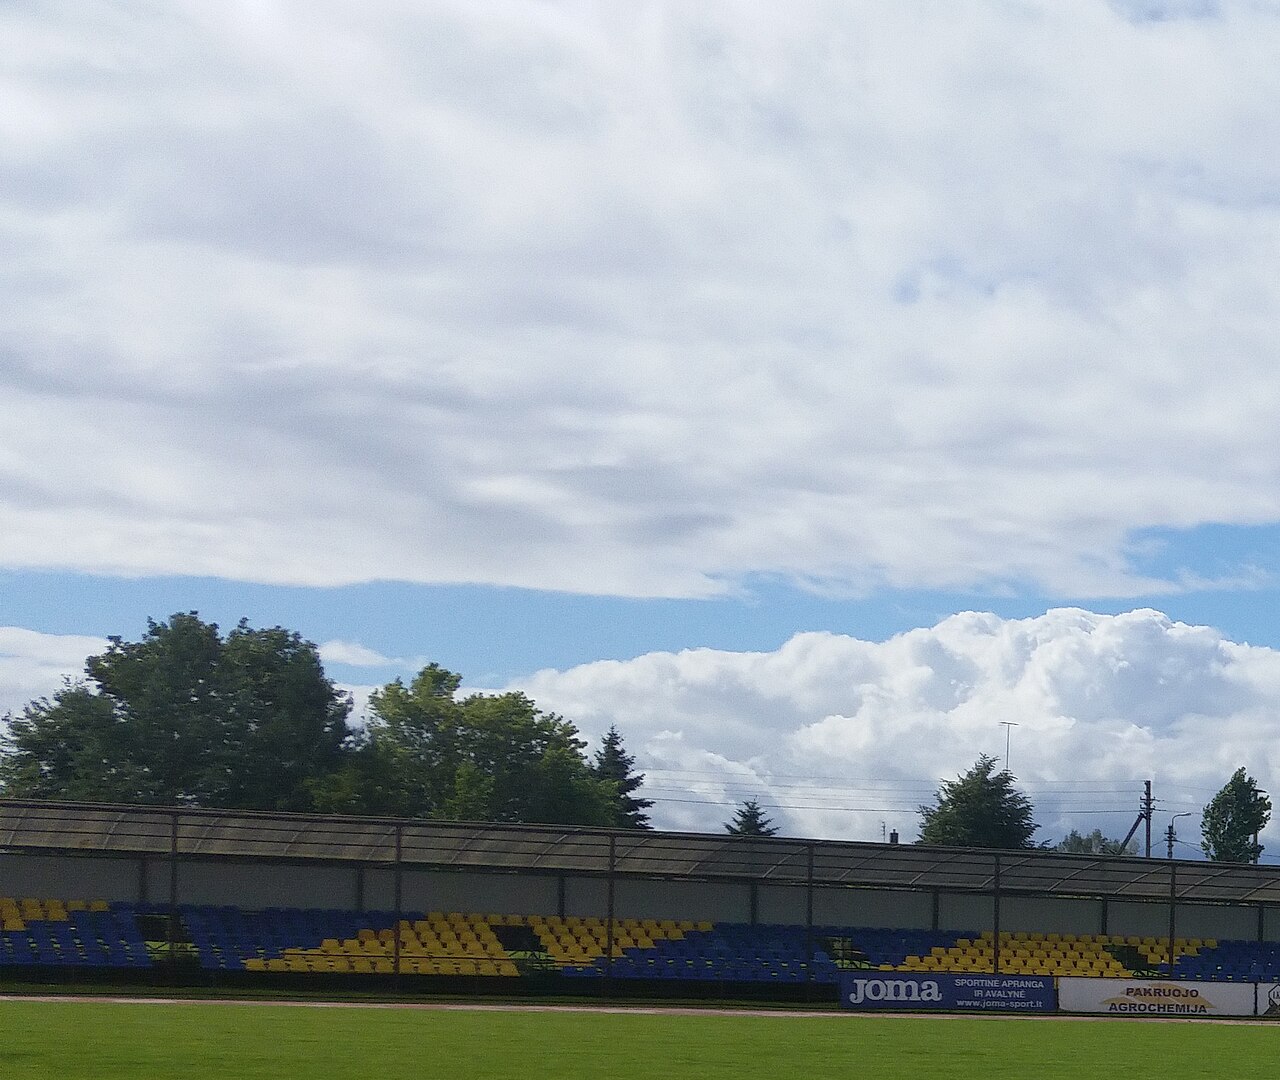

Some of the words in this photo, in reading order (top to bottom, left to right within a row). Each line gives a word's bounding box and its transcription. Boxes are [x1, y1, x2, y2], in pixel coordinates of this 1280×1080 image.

[1001, 980, 1044, 989] APRANGA
[974, 989, 983, 997] IR
[1126, 987, 1199, 998] PAKRUOJO
[1109, 1003, 1208, 1014] AGROCHEMIJA
